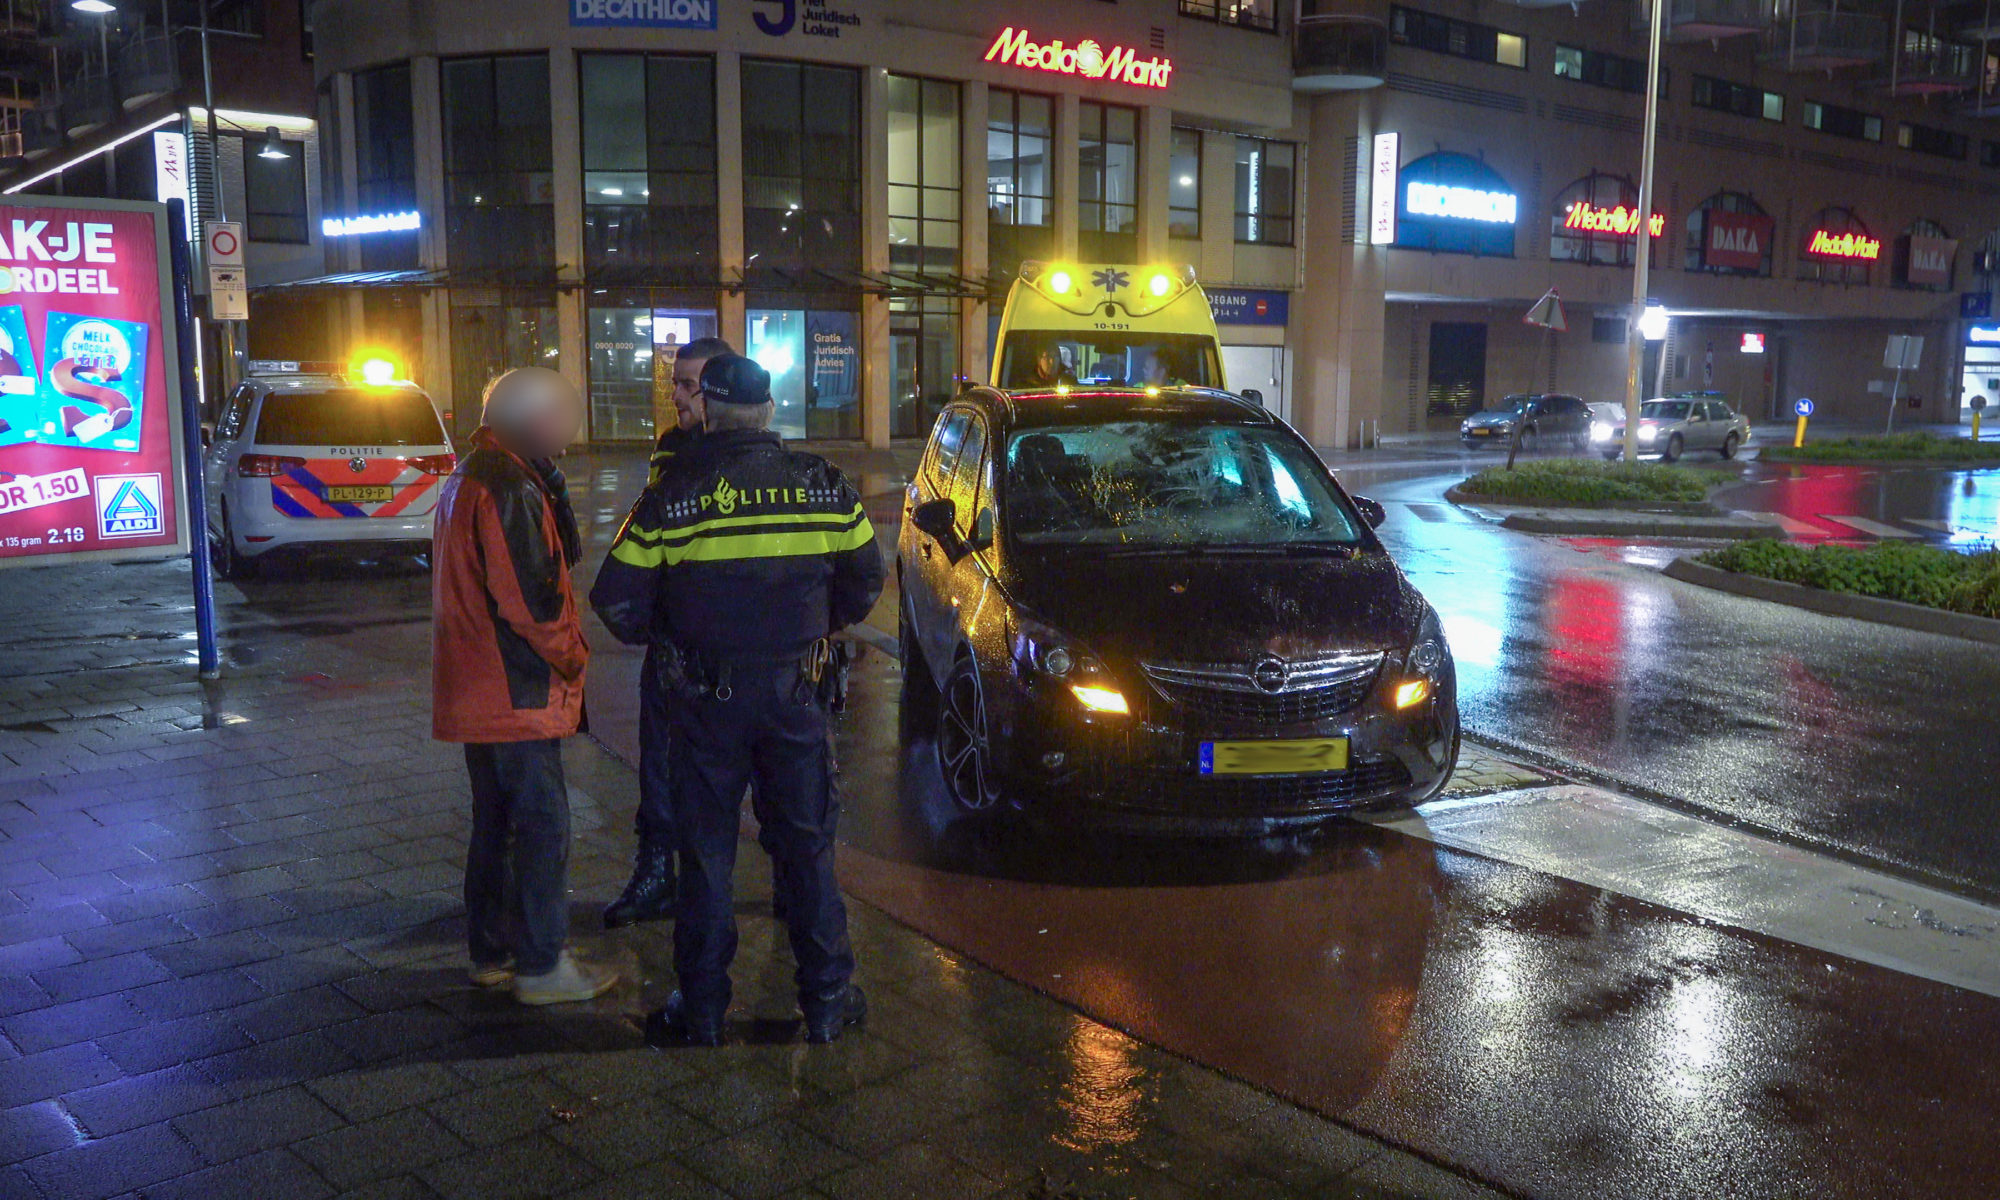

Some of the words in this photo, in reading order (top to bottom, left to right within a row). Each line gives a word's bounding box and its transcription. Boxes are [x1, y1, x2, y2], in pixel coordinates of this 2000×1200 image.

[575, 0, 711, 22] DECATHLON
[802, 8, 861, 26] Juridisch
[802, 22, 840, 38] Loket
[1712, 225, 1759, 253] DAKA
[1093, 322, 1129, 330] 10-191
[814, 333, 842, 343] Gratis
[814, 345, 854, 355] Juridisch
[815, 357, 845, 367] Advies
[330, 447, 383, 455] POLITIE
[33, 475, 79, 501] 1.50
[333, 488, 385, 499] PL-129-P
[111, 518, 154, 532] ALDI
[6, 537, 19, 547] 135
[21, 535, 42, 548] gram
[47, 527, 85, 544] 2.18
[1201, 760, 1212, 769] NL
